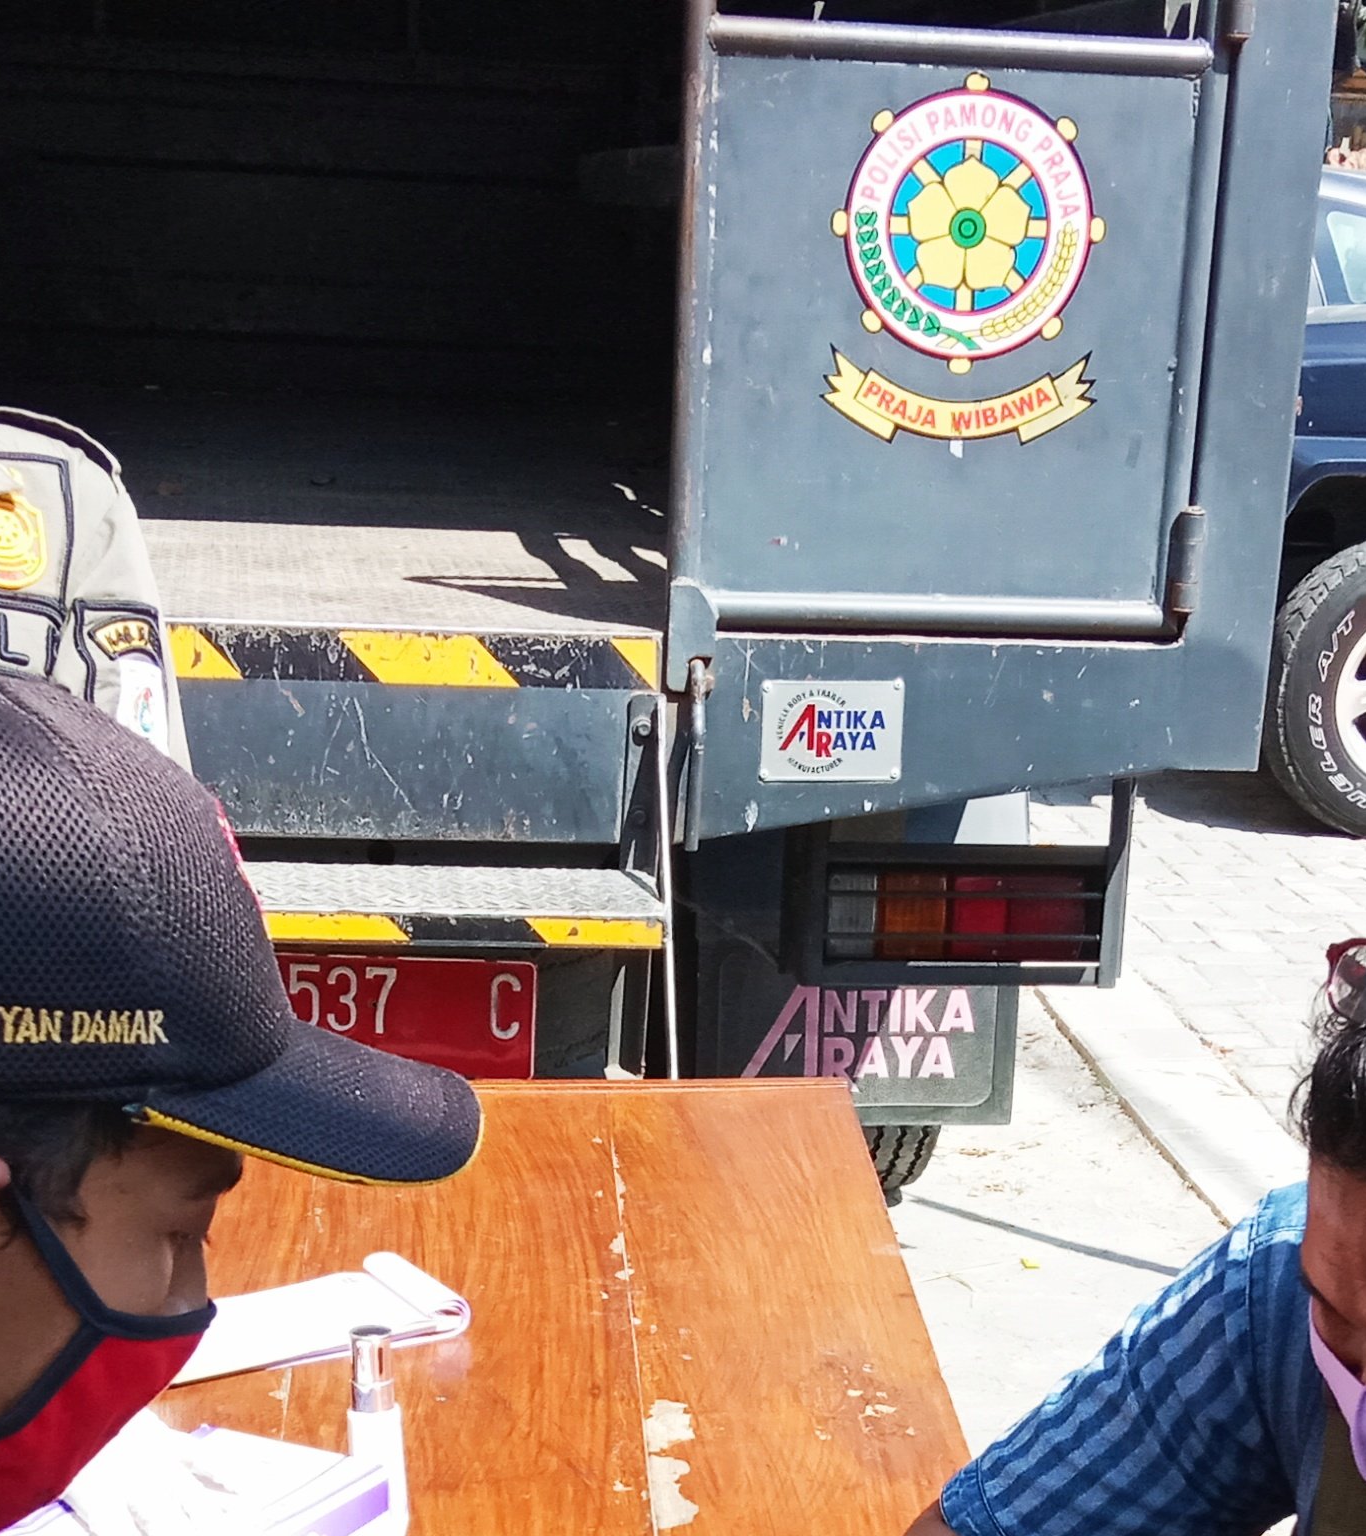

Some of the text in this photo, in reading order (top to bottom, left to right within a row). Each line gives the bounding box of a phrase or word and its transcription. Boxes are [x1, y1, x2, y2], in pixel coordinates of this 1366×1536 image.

[861, 103, 1082, 219] POLISI PAMONG PRAJA
[862, 380, 1052, 433] PRAJA WIBAWA
[1318, 609, 1356, 682] A/T
[779, 703, 886, 751] ANTIKA
[815, 731, 876, 758] RAYA
[70, 1008, 170, 1045] DAMAR
[490, 973, 522, 1040] C
[740, 983, 976, 1078] ANTIKA
[821, 1035, 956, 1093] RAYA
